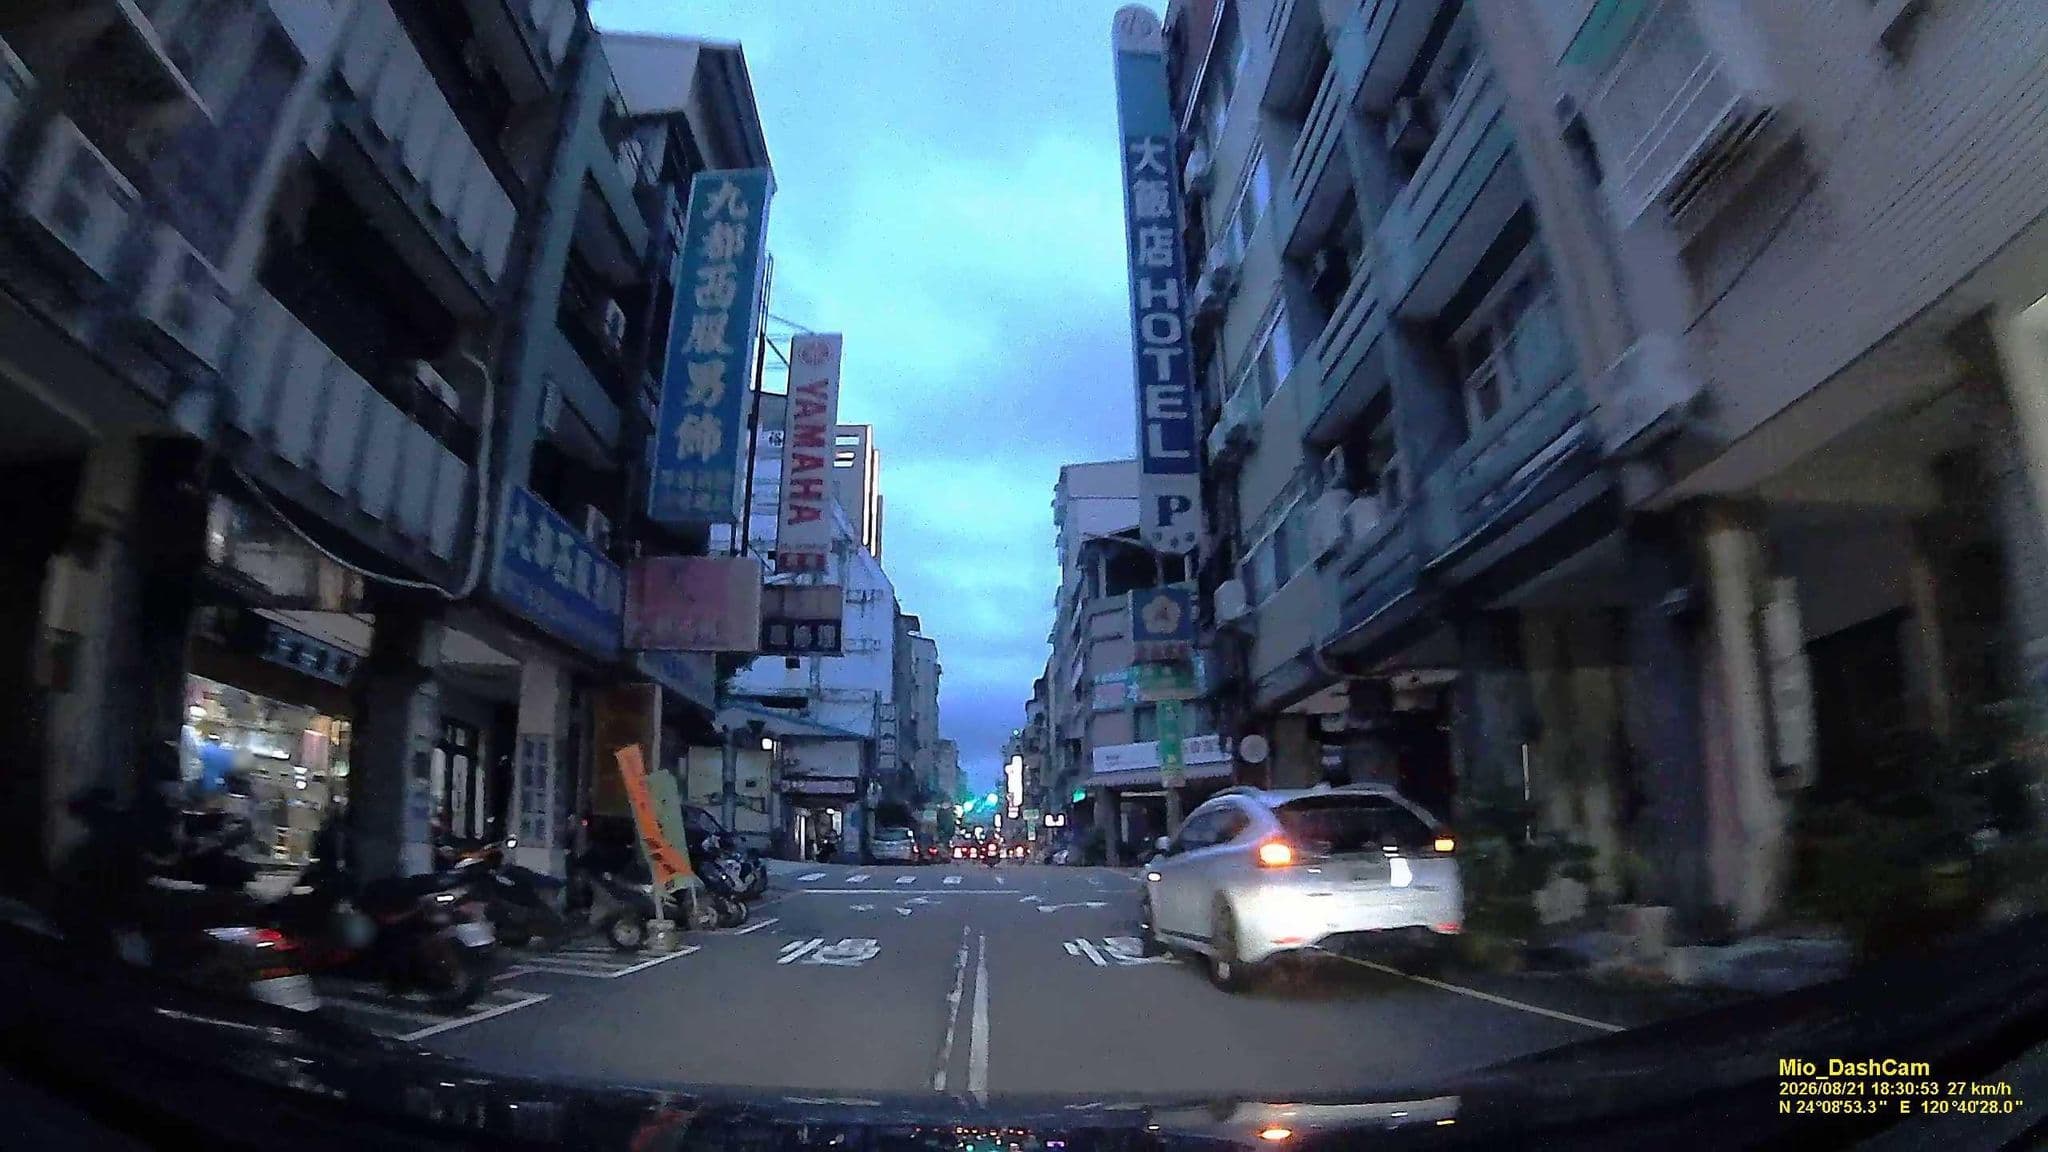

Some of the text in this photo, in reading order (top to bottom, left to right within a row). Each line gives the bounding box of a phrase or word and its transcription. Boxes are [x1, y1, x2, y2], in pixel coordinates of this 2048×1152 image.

[1139, 277, 1191, 459] HOTEL
[787, 377, 829, 526] YAMAHA
[1157, 495, 1192, 527] P
